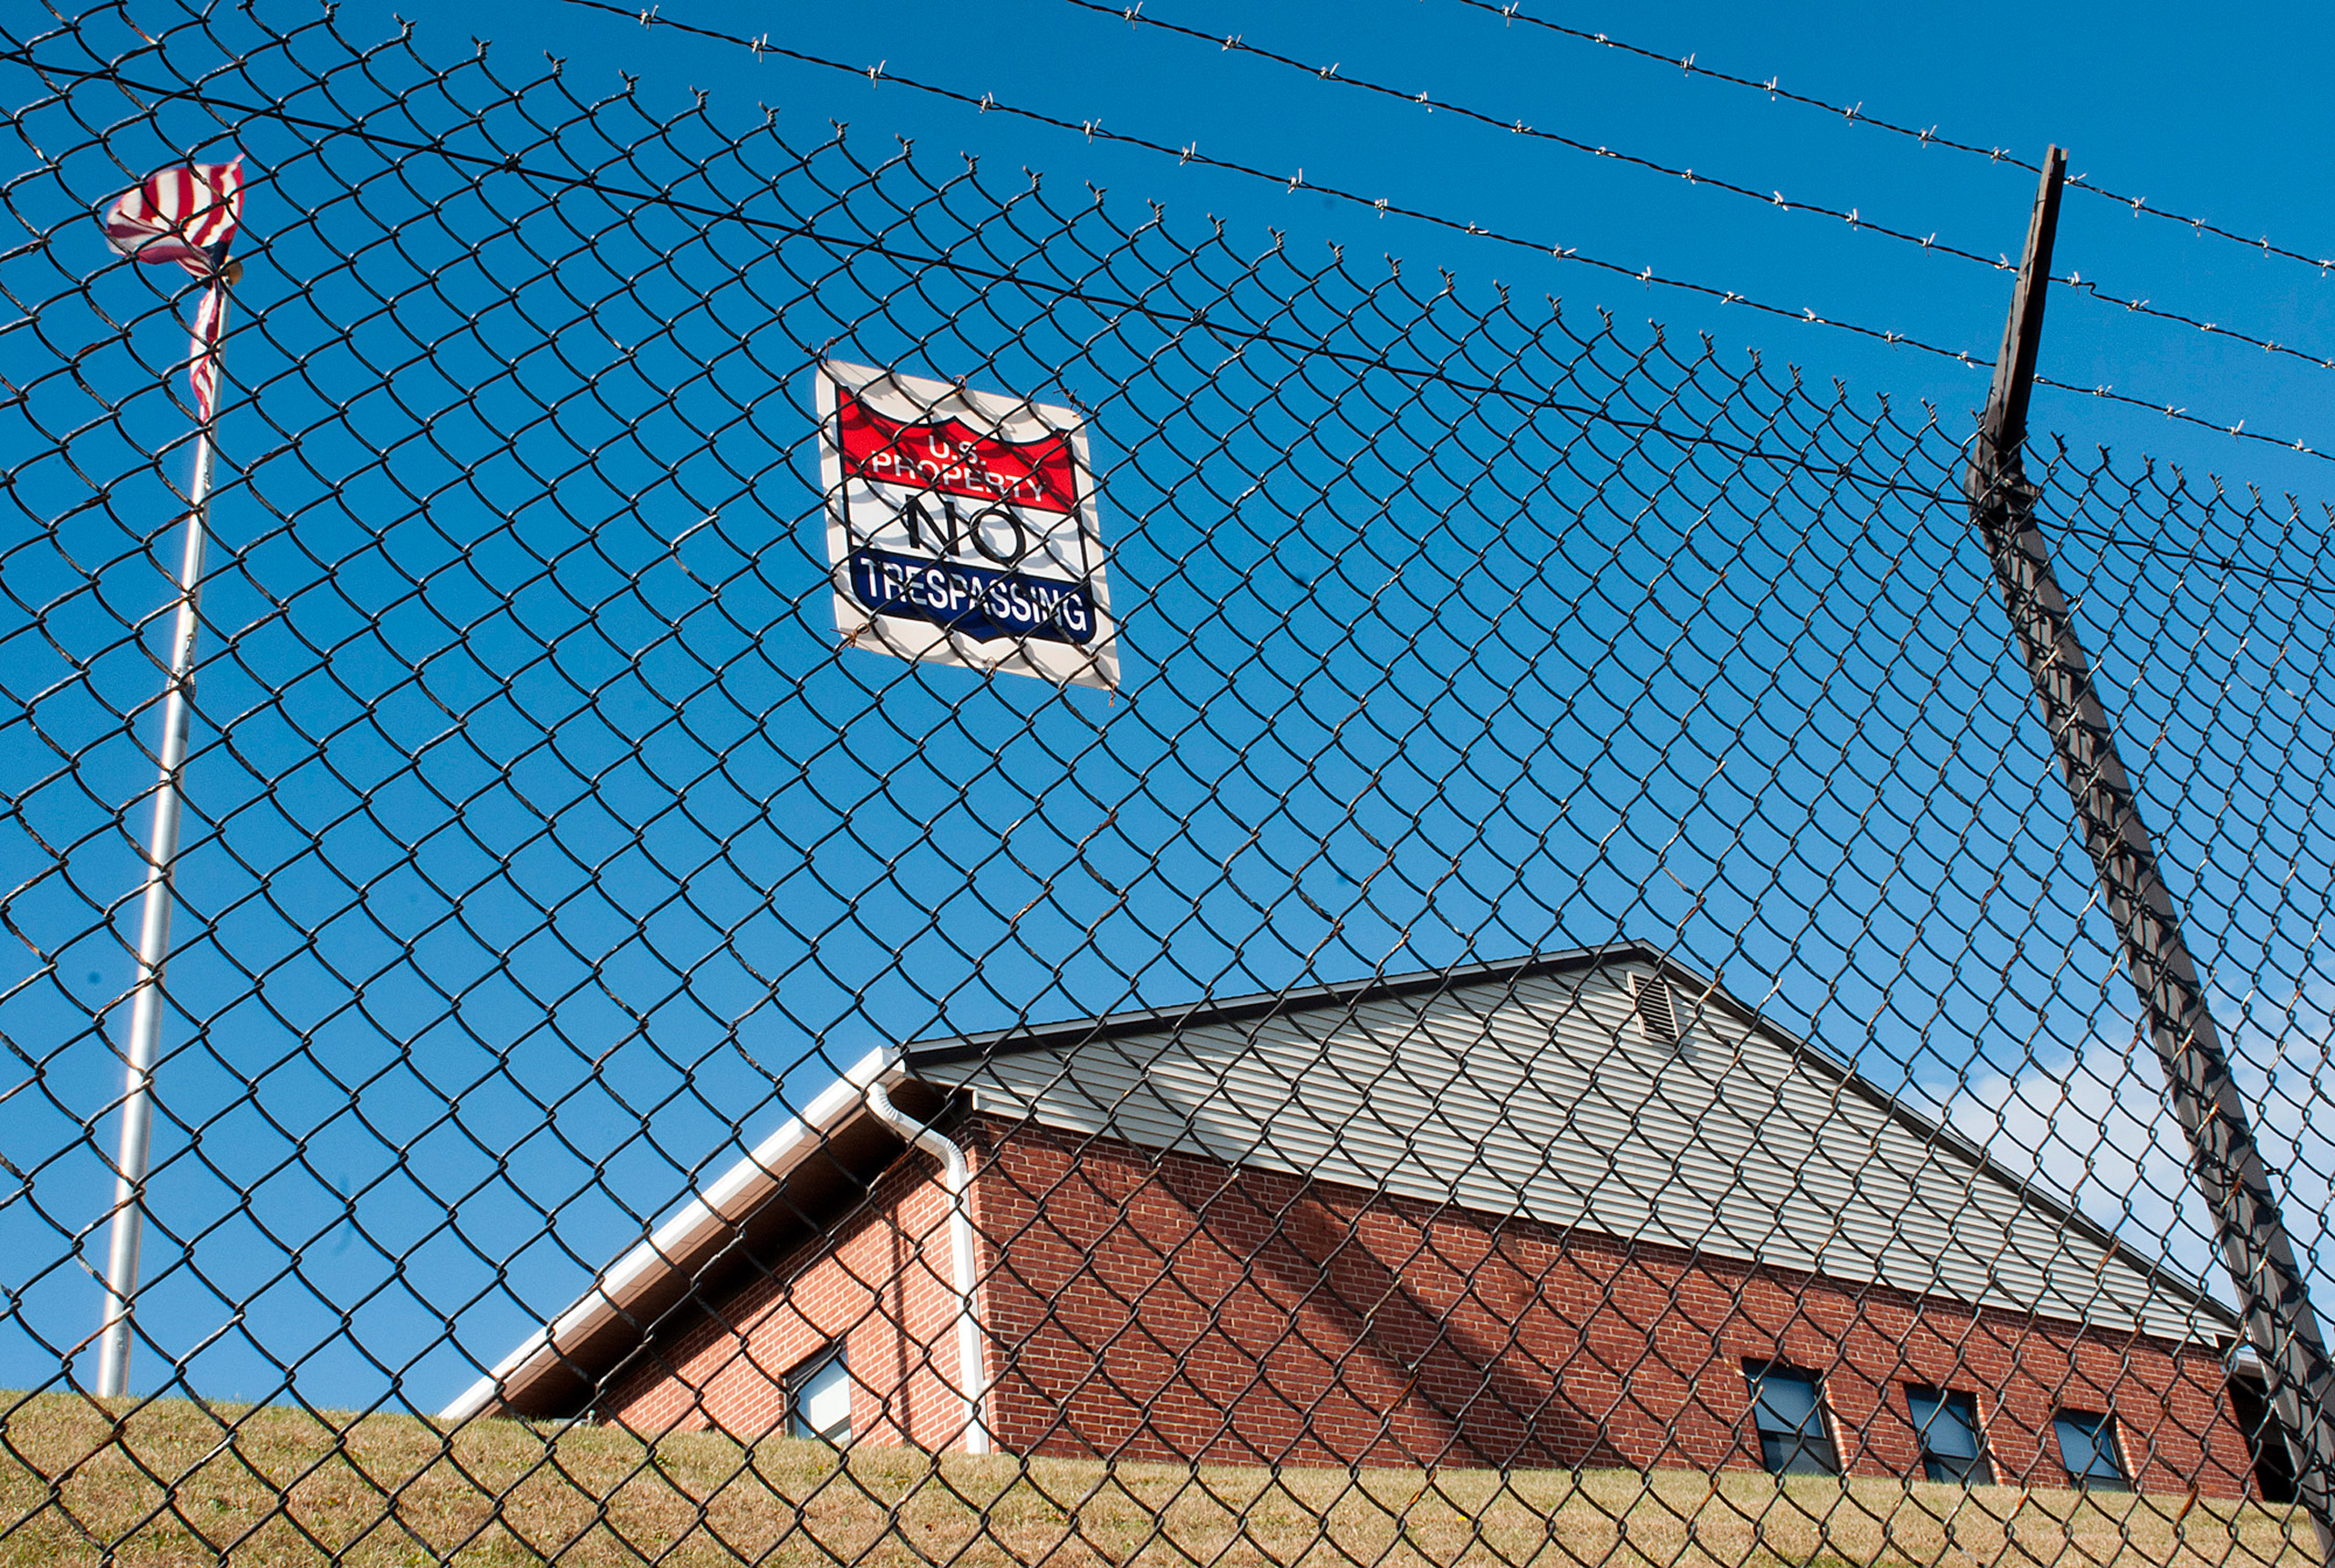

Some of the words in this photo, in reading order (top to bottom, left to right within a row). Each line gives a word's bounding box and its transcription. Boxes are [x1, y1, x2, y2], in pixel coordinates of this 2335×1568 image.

[872, 451, 1046, 502] PROPERTY
[929, 434, 987, 466] U.S.
[905, 493, 1026, 564] NO
[860, 557, 1087, 632] TRESPASSING
